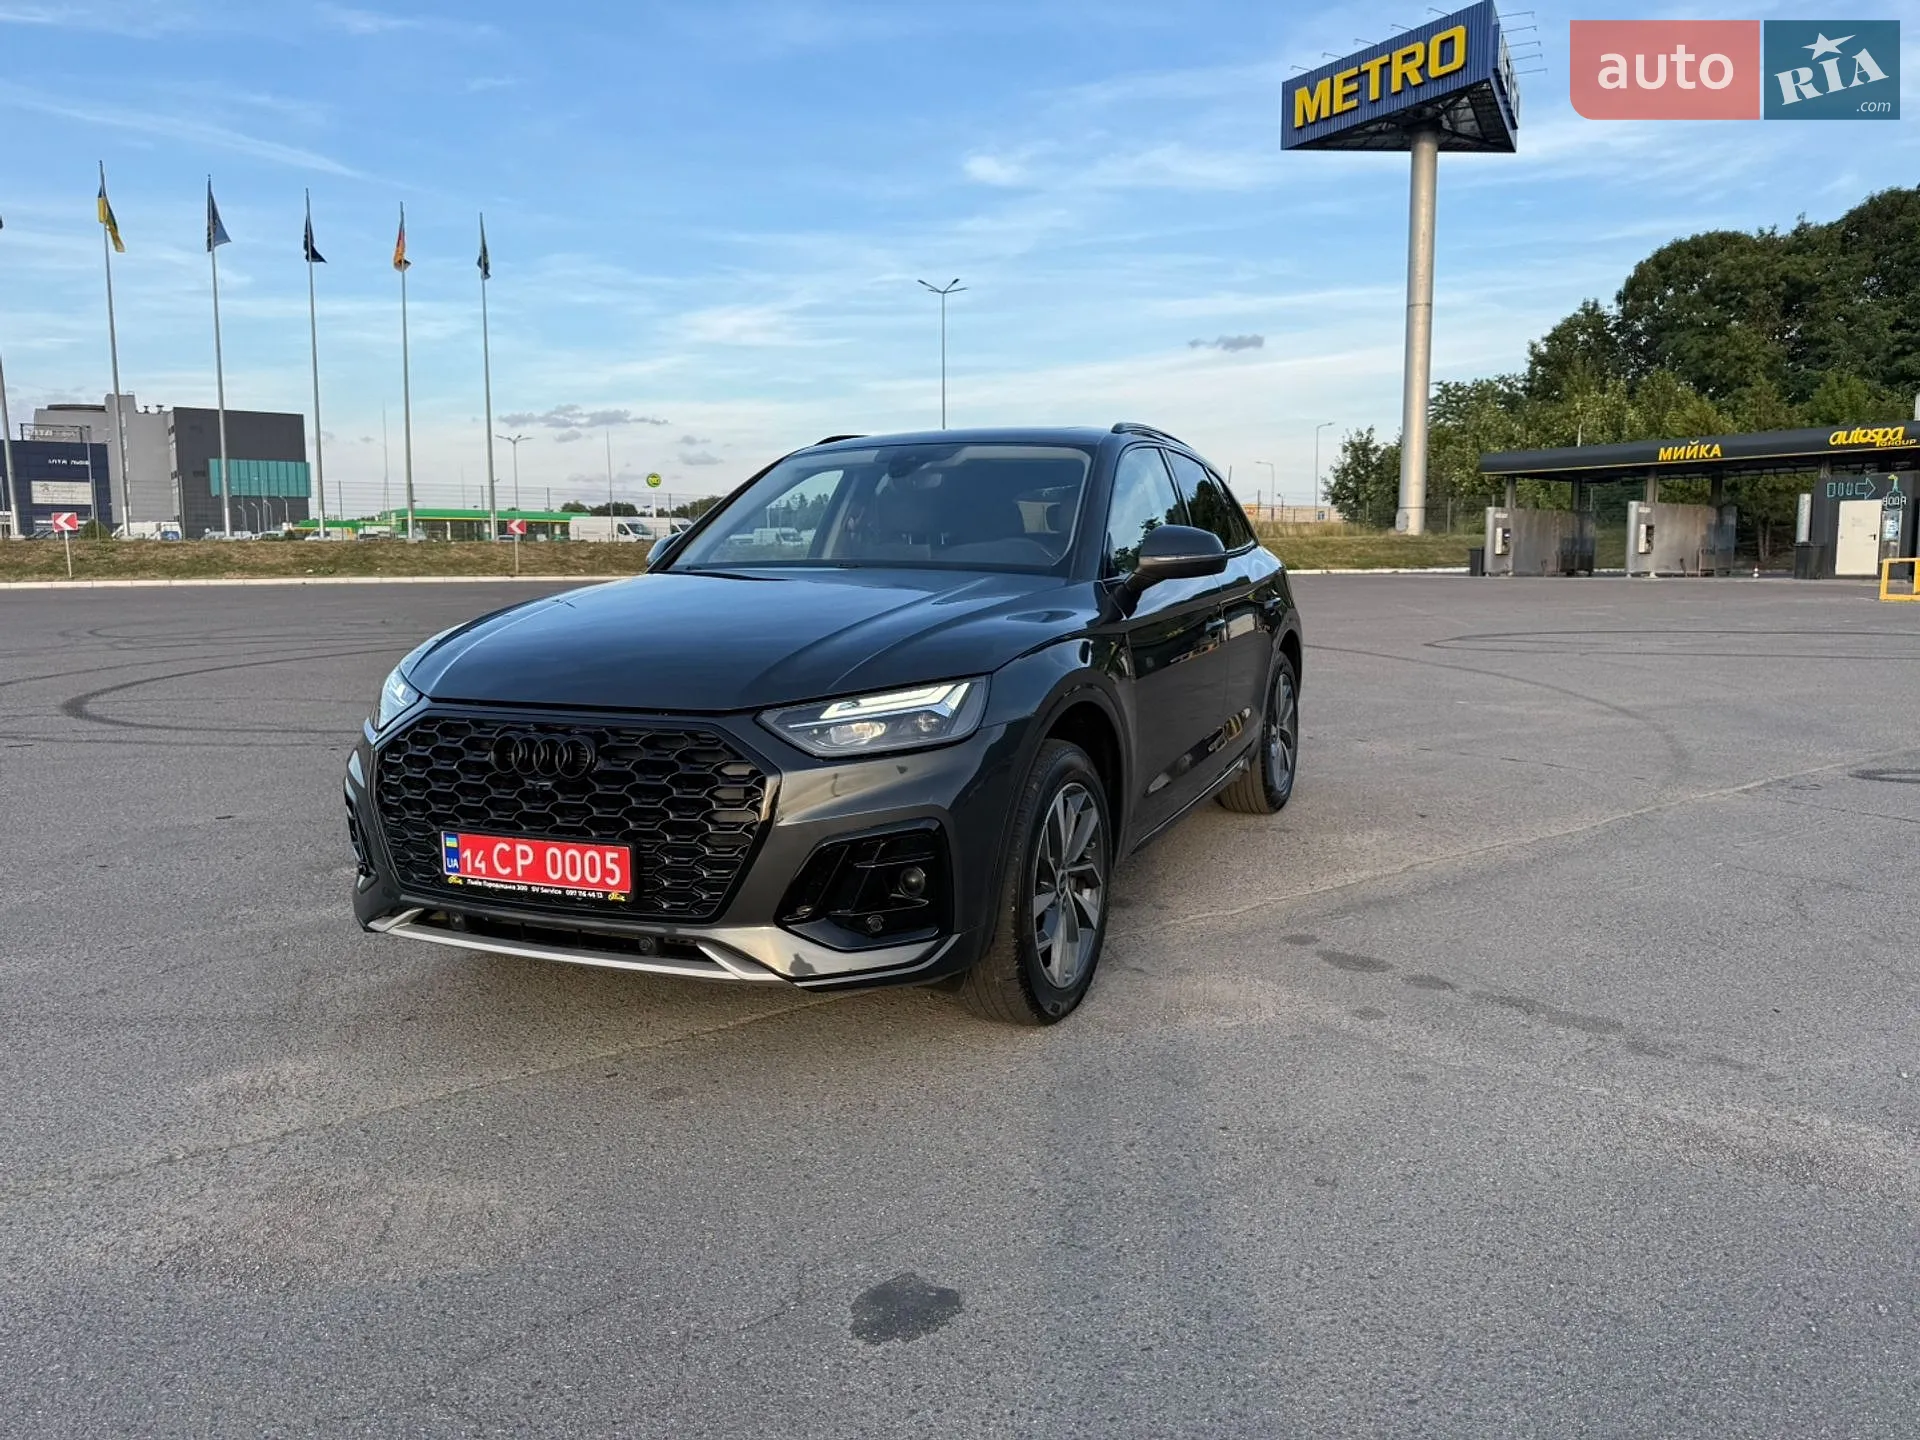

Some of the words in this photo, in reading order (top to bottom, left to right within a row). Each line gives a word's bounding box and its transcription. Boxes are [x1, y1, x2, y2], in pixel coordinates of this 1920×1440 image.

[1293, 24, 1468, 129] METRO
[1829, 426, 1905, 448] autospa
[1880, 438, 1917, 447] GROUP
[1658, 439, 1722, 461] МИЙКА
[446, 858, 459, 869] UA
[462, 849, 487, 875] 14
[493, 843, 534, 877] CP
[546, 847, 621, 886] 0005
